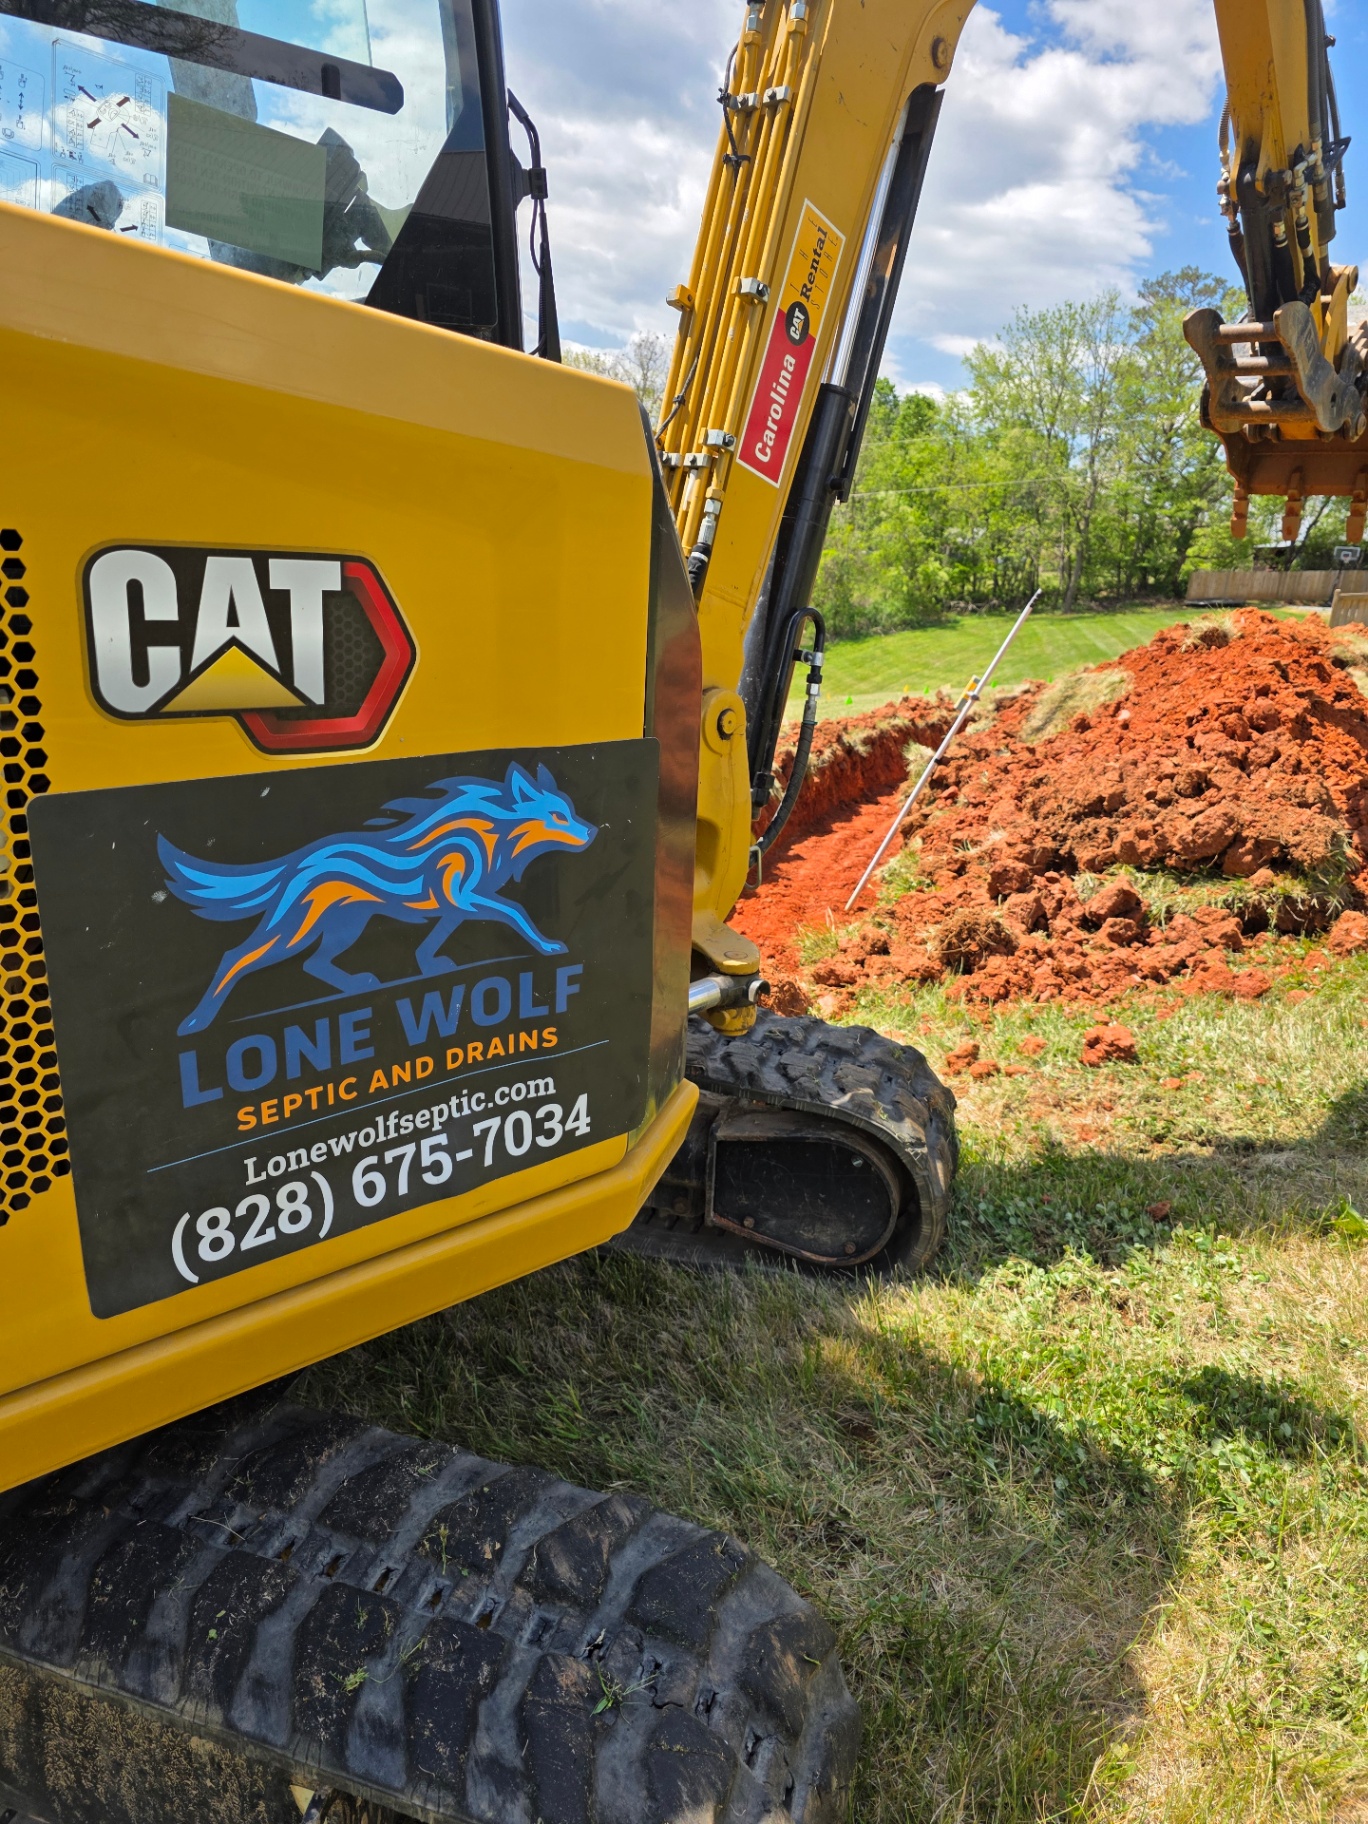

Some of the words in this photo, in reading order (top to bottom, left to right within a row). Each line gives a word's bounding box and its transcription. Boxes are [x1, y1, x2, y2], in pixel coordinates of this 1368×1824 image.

[800, 226, 828, 303] Rental
[789, 307, 807, 340] CAT
[754, 354, 796, 463] Carolina
[90, 550, 341, 713] CAT
[179, 1007, 375, 1109] LONE
[396, 964, 584, 1046] WOLF
[237, 1077, 358, 1131] SEPTIC
[369, 1056, 434, 1094] AND
[446, 1027, 559, 1071] DRAINS
[244, 1075, 556, 1187] Lonewolfseptic.com
[171, 1171, 334, 1284] (828)
[352, 1093, 592, 1209] 675-7034
